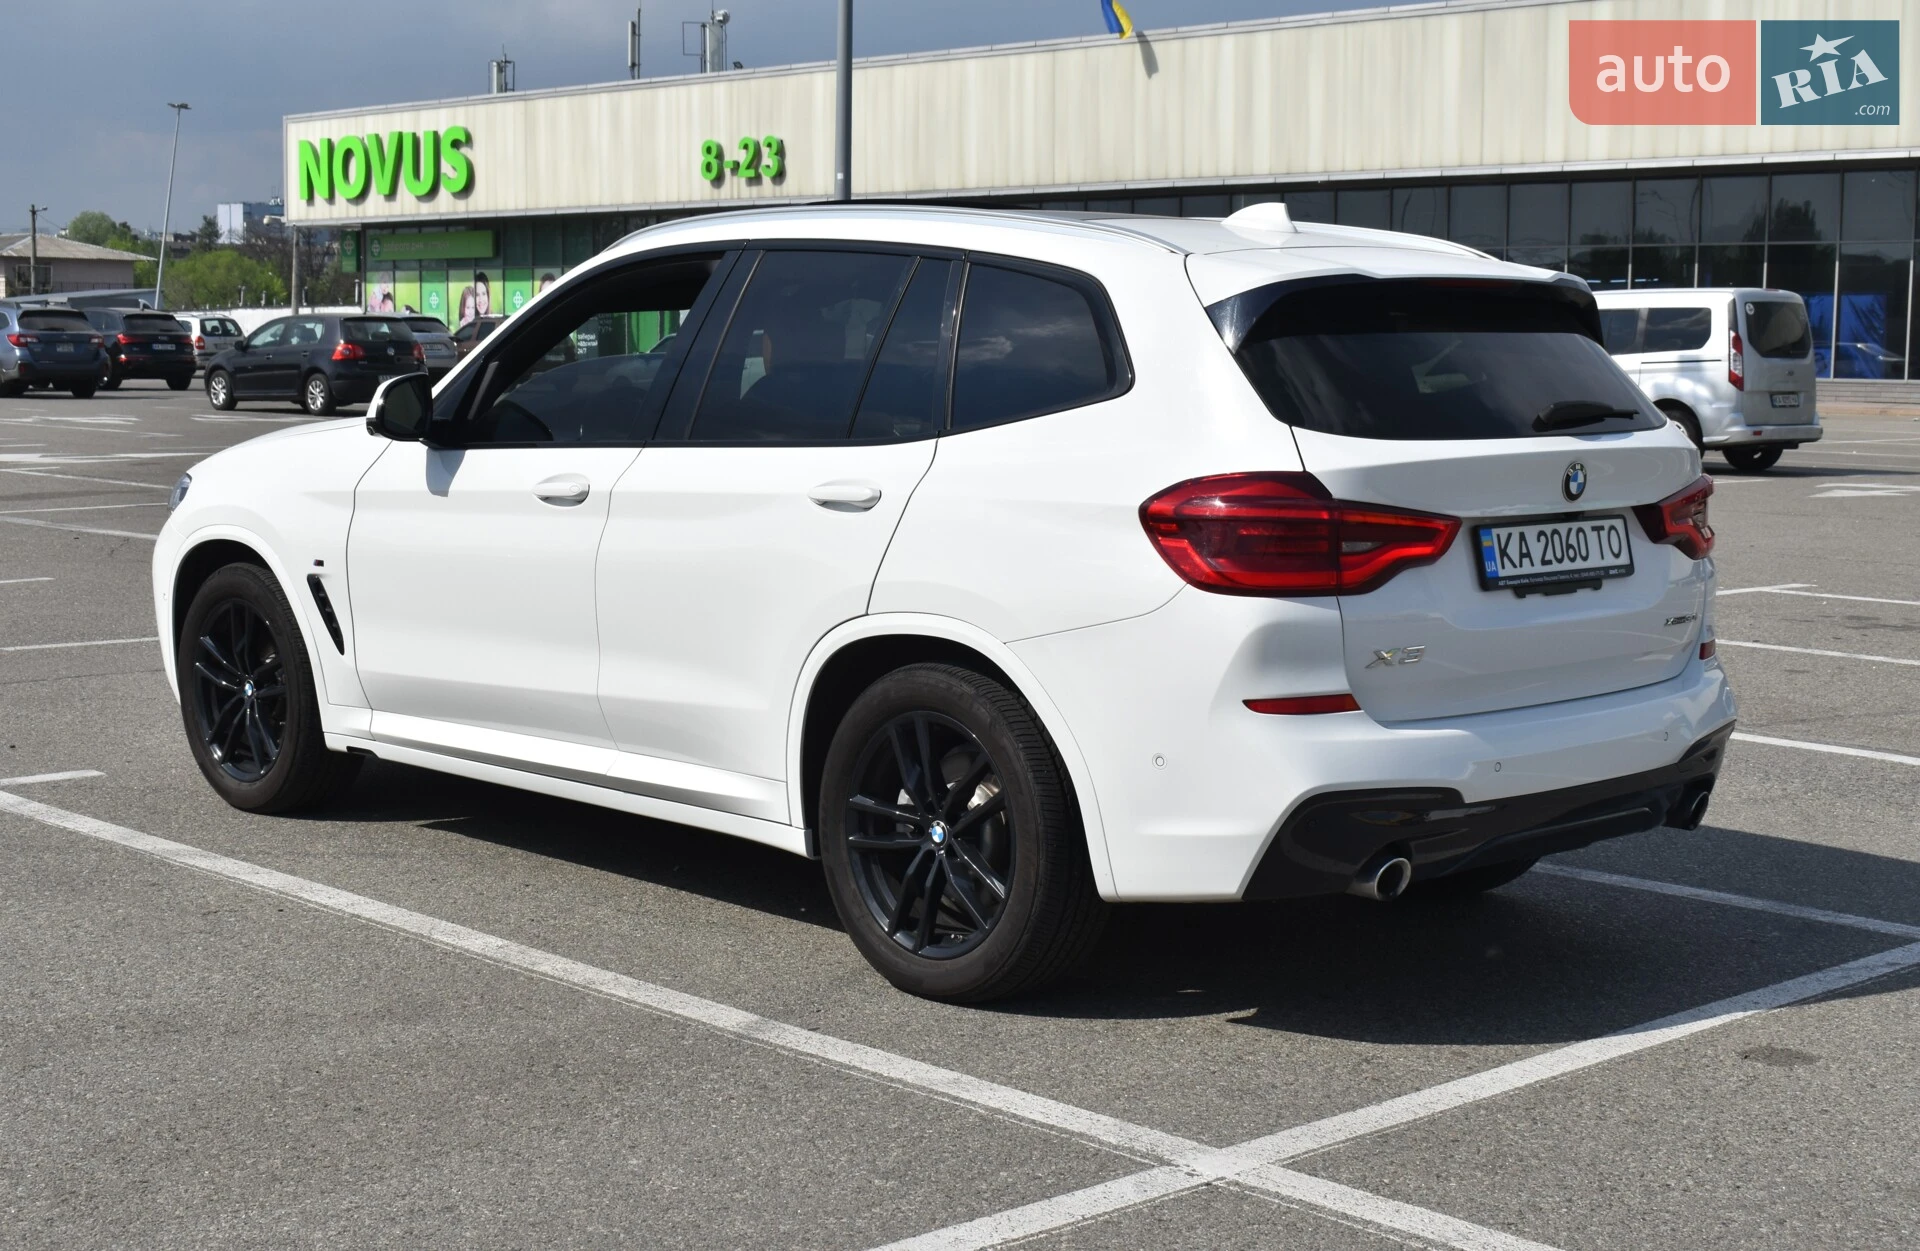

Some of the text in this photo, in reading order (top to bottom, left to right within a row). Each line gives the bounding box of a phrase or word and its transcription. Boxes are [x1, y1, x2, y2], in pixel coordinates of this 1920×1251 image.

[299, 125, 472, 201] NOVUS
[701, 135, 783, 181] 8-23
[1485, 560, 1497, 574] UA
[1496, 524, 1622, 570] KA 2060 TO
[1364, 645, 1426, 669] X3
